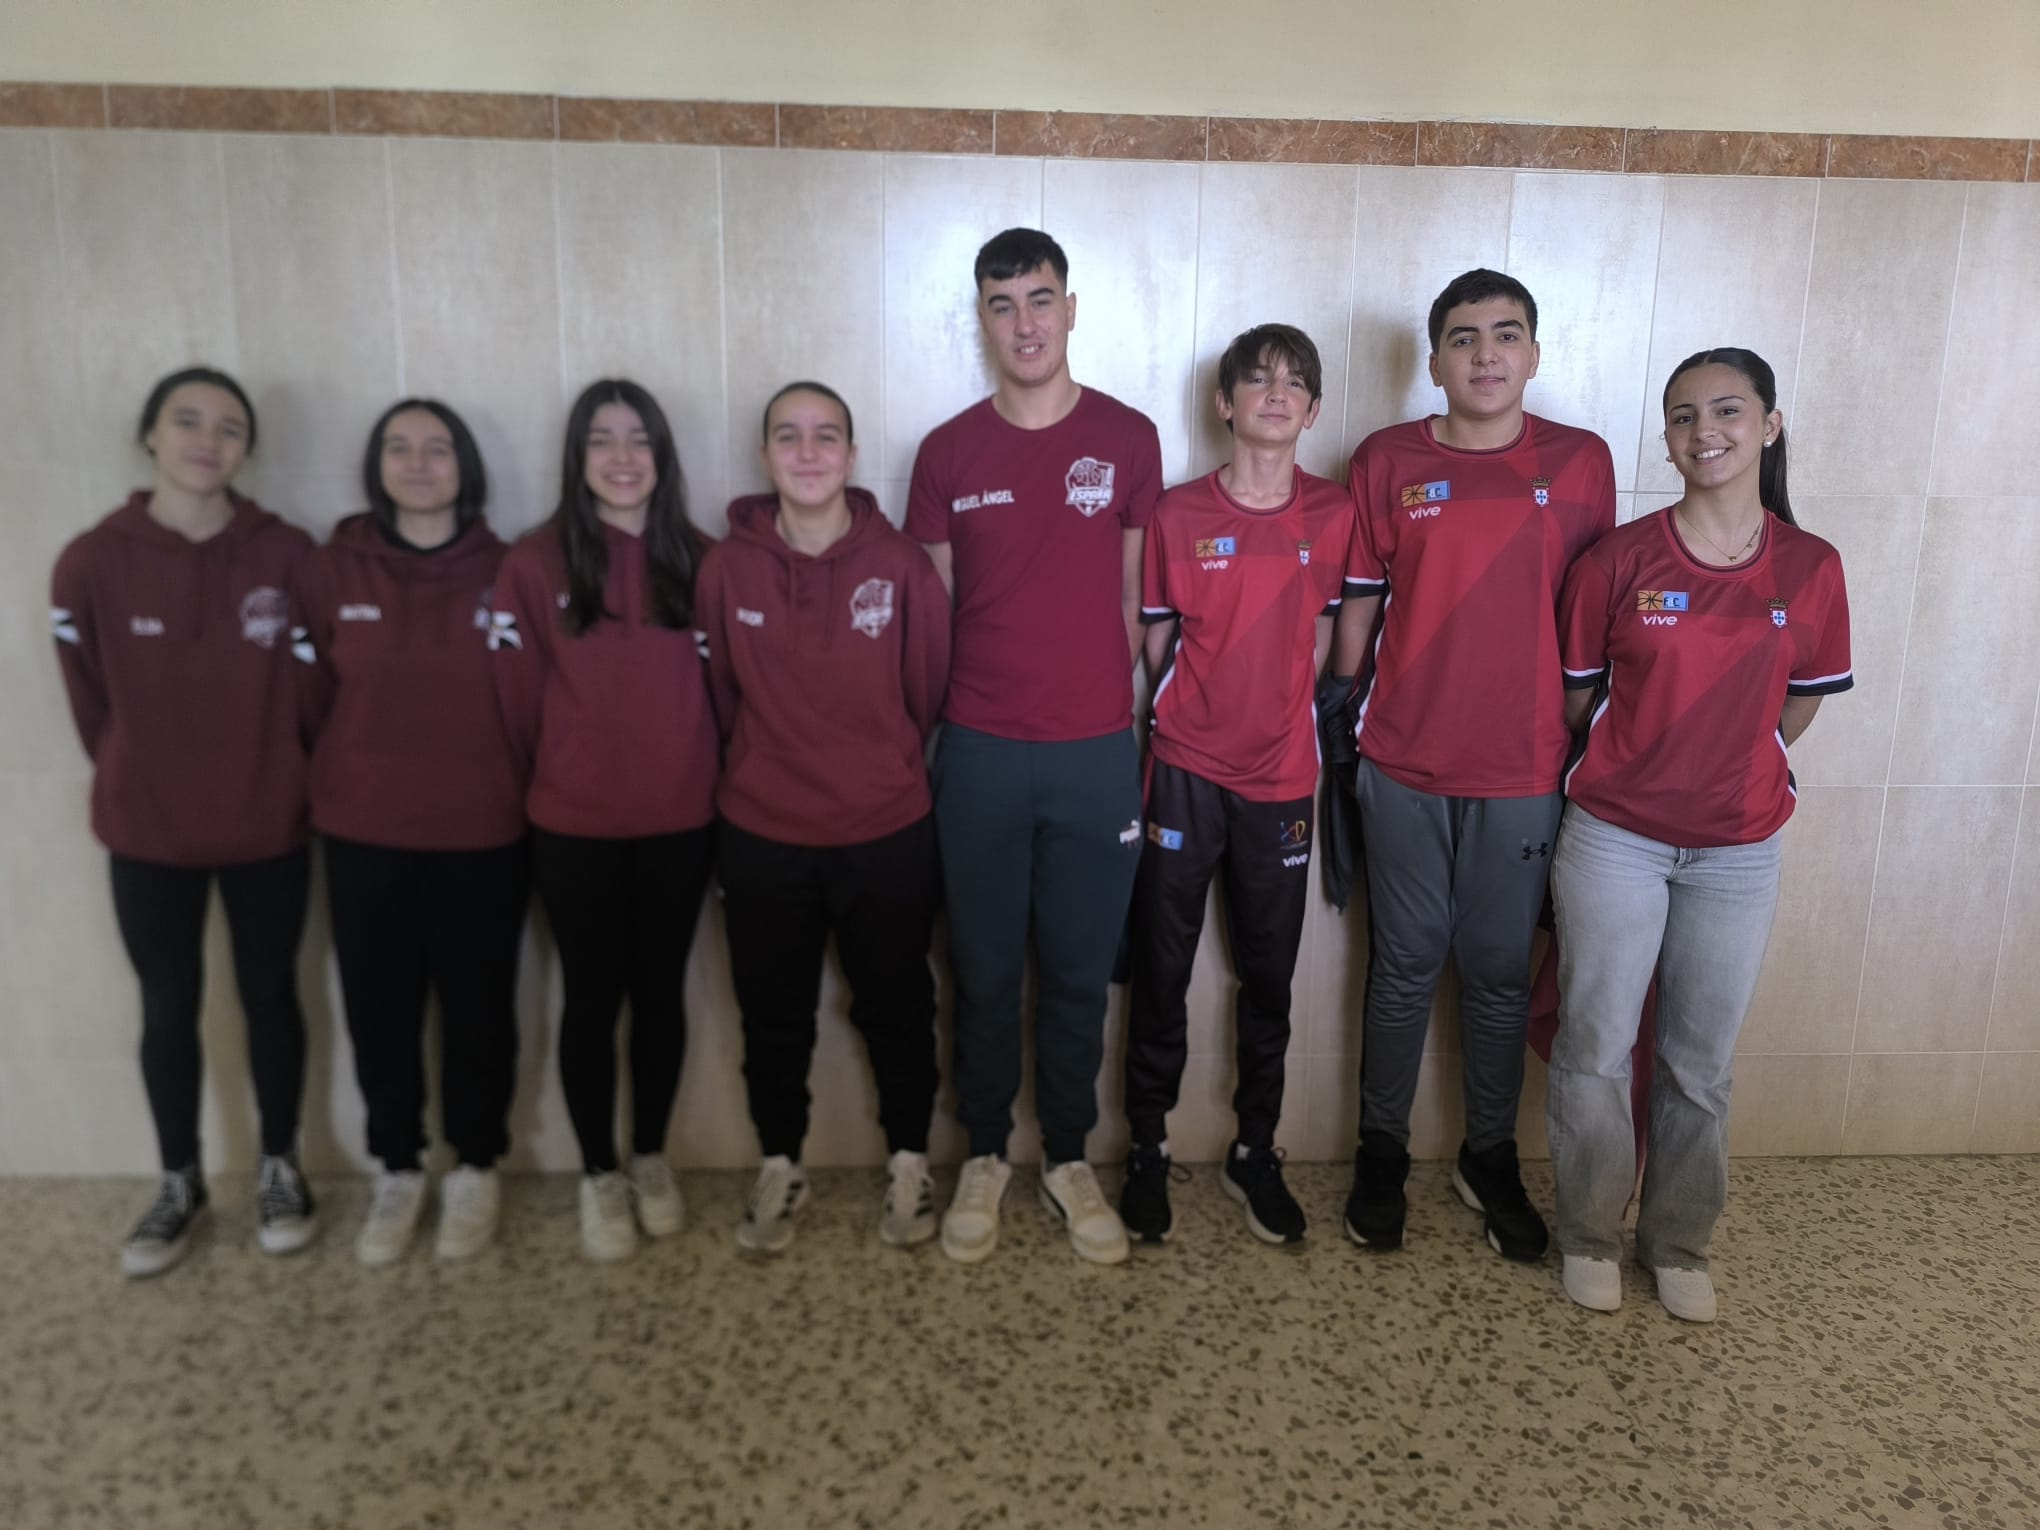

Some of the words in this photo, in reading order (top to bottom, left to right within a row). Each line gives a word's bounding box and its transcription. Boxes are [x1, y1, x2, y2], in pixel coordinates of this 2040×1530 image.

[1409, 505, 1441, 520] vive
[1201, 559, 1229, 571] vive
[1642, 613, 1678, 626] vive
